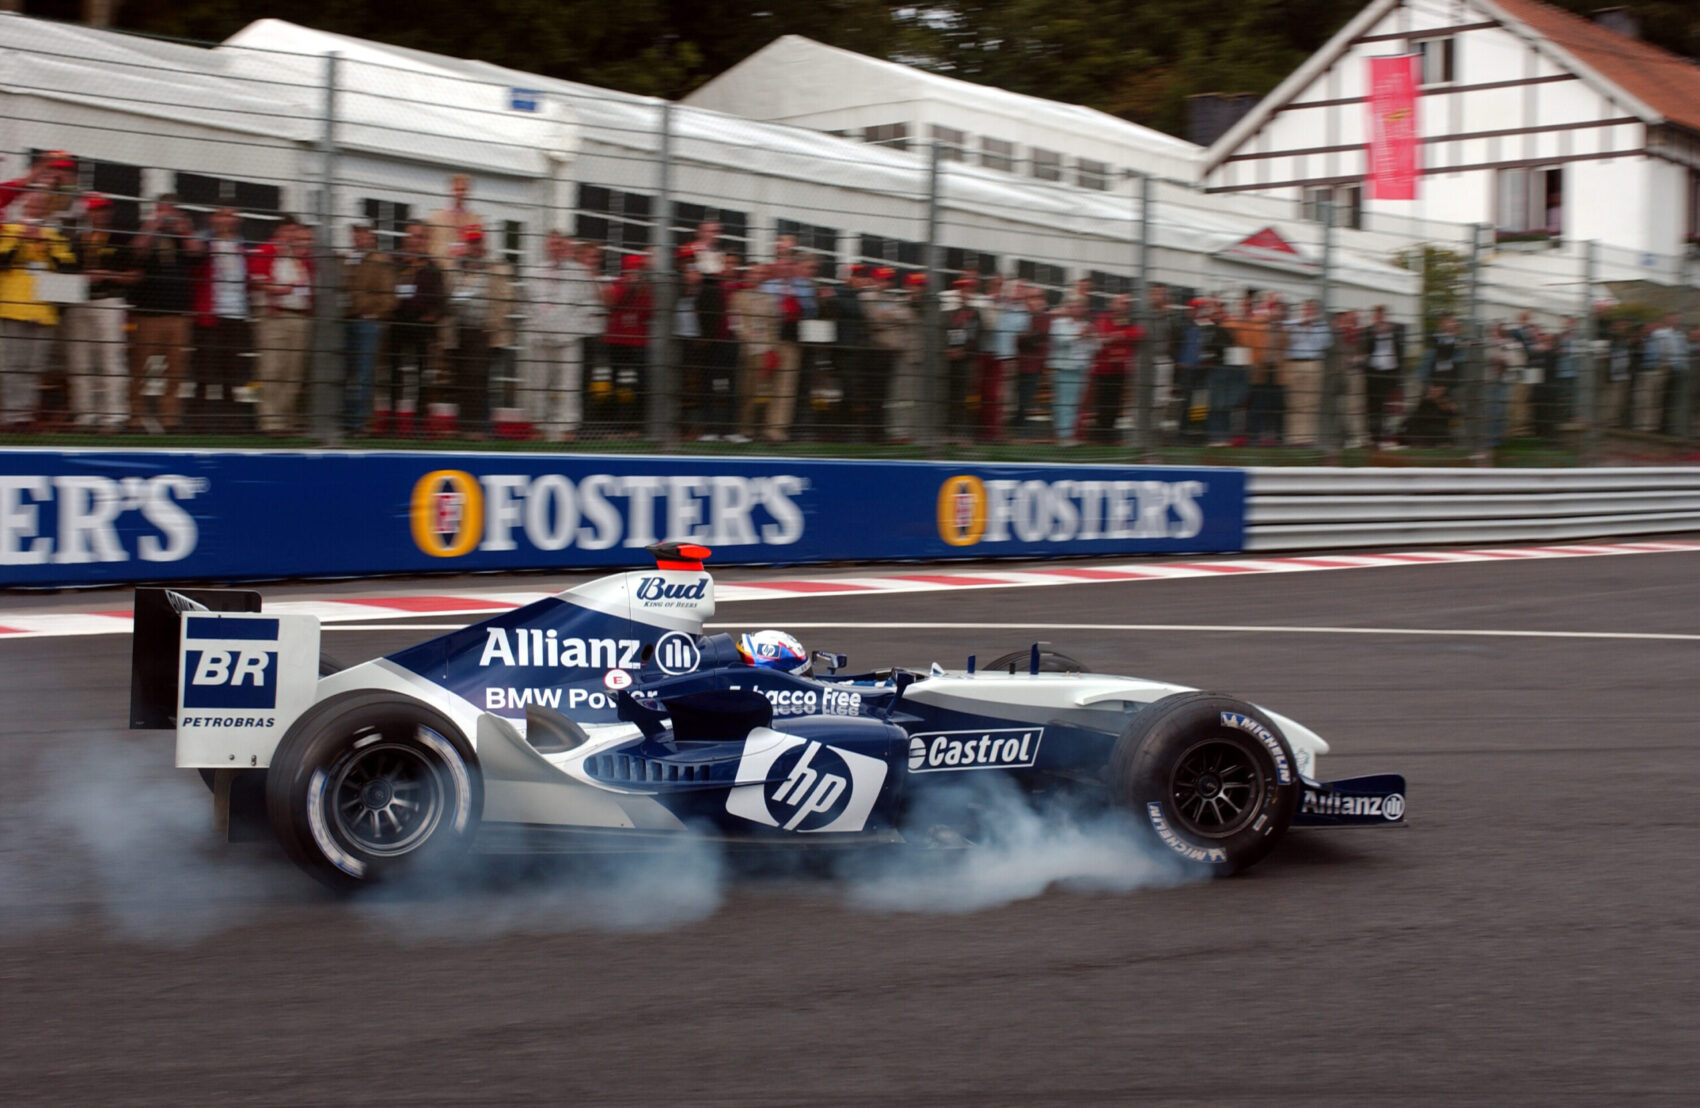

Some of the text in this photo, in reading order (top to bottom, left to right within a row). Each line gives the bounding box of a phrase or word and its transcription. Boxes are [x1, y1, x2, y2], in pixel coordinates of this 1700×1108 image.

[479, 474, 806, 551] FOSTER'S
[982, 480, 1205, 542] FOSTER'S
[636, 576, 709, 600] Bud
[479, 627, 641, 670] Allianz
[192, 649, 270, 686] BR
[613, 676, 624, 685] E
[485, 688, 562, 709] BMW
[822, 687, 861, 707] Free
[182, 717, 275, 728] PETROBRAS
[929, 733, 1032, 767] Castrol
[1241, 717, 1291, 783] MICHELIN
[772, 740, 847, 831] hp
[1302, 790, 1382, 815] Allianz
[1149, 804, 1207, 861] MICHELIN
